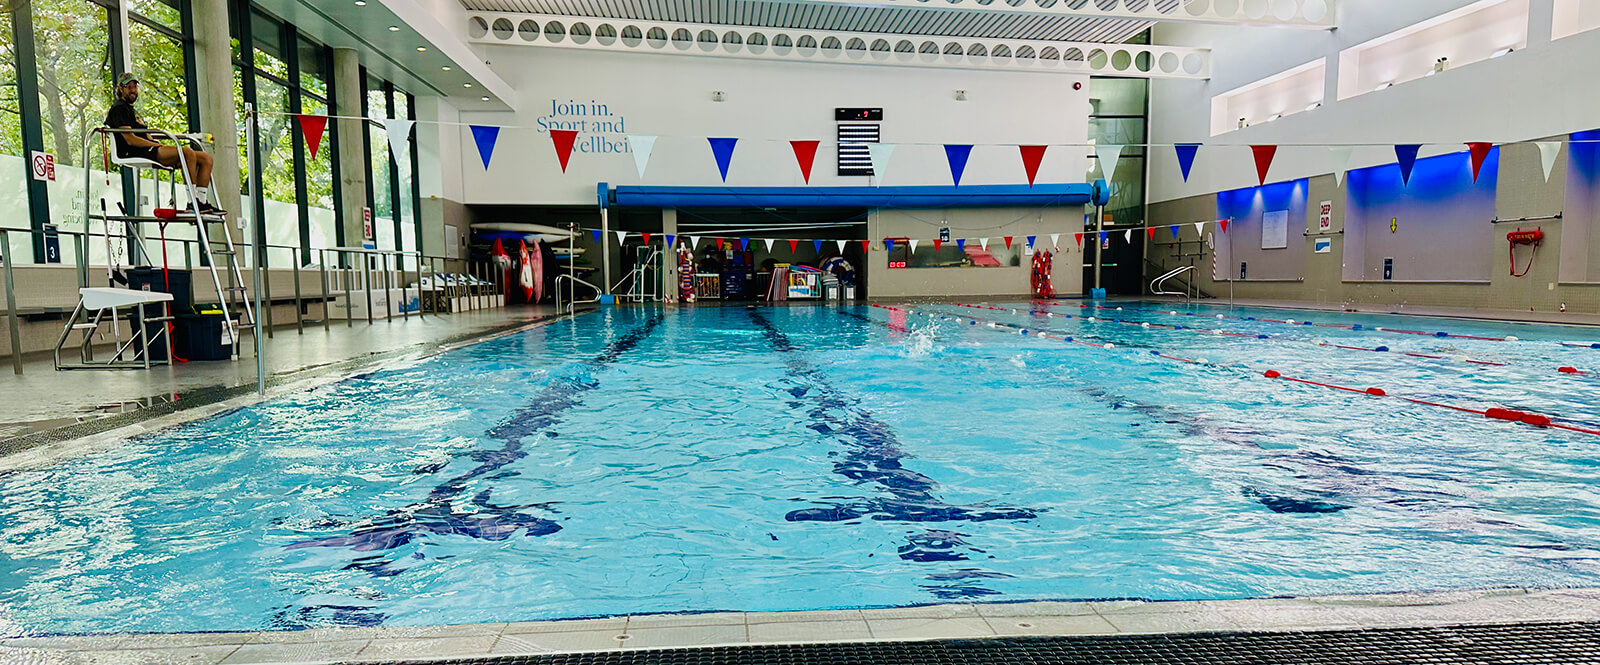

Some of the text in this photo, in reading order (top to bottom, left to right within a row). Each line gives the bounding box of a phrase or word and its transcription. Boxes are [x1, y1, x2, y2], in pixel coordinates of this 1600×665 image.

[549, 99, 614, 118] Join in.
[536, 116, 625, 138] Sport and
[49, 246, 56, 259] 3
